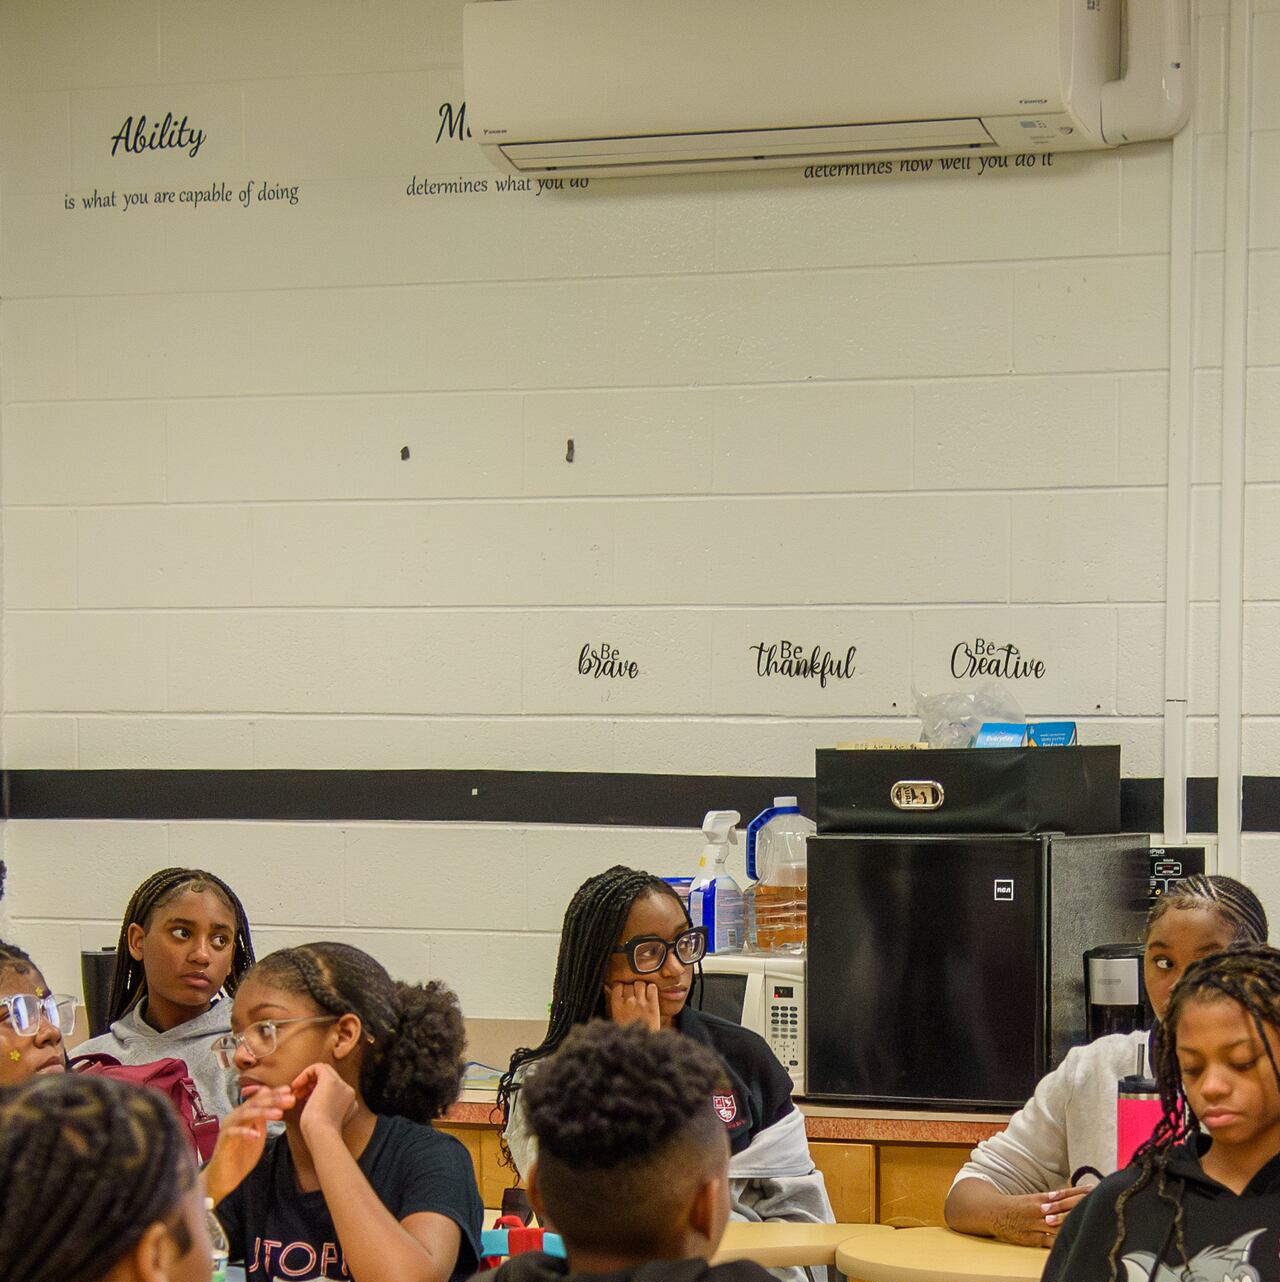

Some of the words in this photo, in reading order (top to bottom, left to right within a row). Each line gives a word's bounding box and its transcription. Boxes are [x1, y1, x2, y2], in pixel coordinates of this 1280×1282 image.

[110, 111, 208, 159] Ability
[976, 153, 1010, 177] you
[64, 193, 76, 210] is
[82, 188, 118, 210] what
[122, 192, 149, 212] you
[153, 191, 176, 205] are
[178, 181, 234, 209] capable
[238, 180, 256, 208] of
[257, 180, 301, 206] doing
[405, 175, 489, 197] determines
[495, 174, 533, 193] what
[536, 177, 565, 197] you
[600, 643, 621, 661] Be
[780, 640, 804, 660] Be
[950, 641, 1047, 681] Creative
[974, 637, 996, 657] Be
[577, 643, 640, 680] brave
[749, 644, 857, 689] thankful
